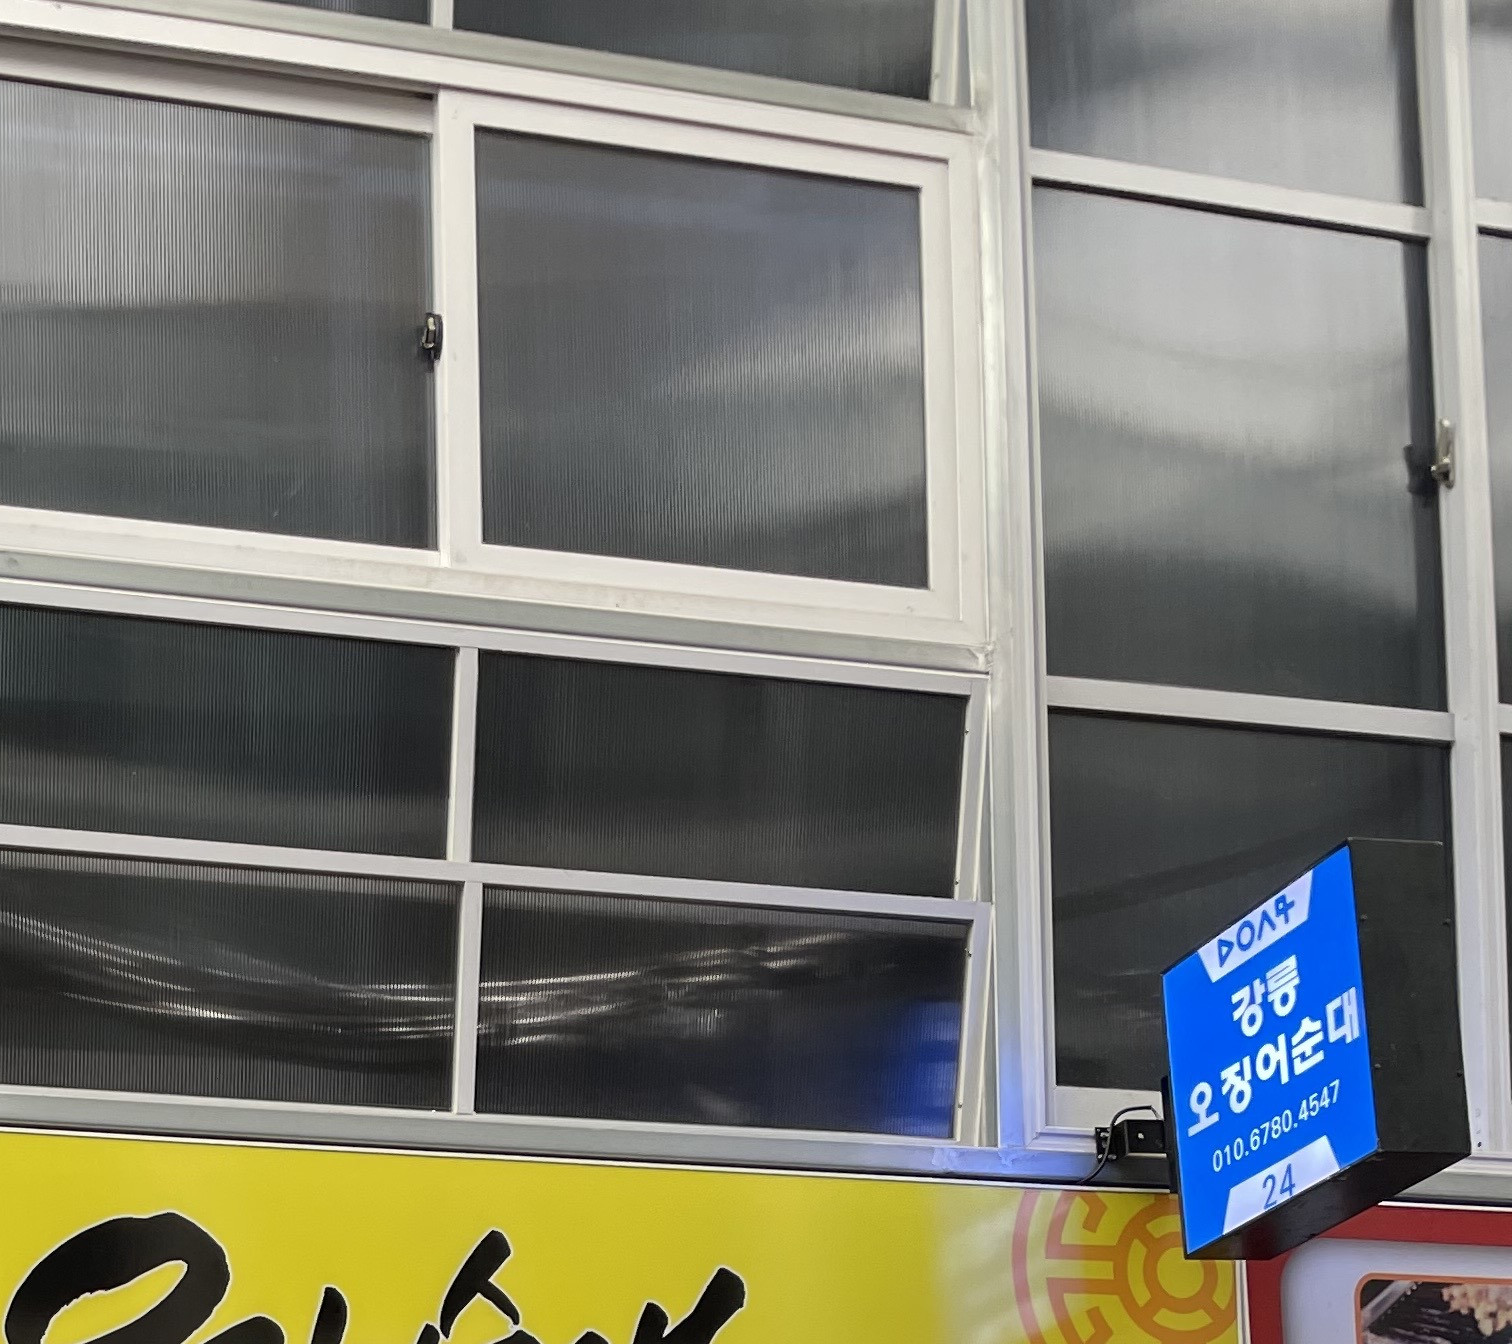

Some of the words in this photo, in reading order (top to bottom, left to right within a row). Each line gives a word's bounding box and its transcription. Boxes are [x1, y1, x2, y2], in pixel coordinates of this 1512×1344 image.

[1230, 954, 1301, 1037] 강릉
[1188, 986, 1361, 1137] 오징어순대
[1212, 1079, 1341, 1173] 010.6780.4547
[1262, 1163, 1296, 1211] 24
